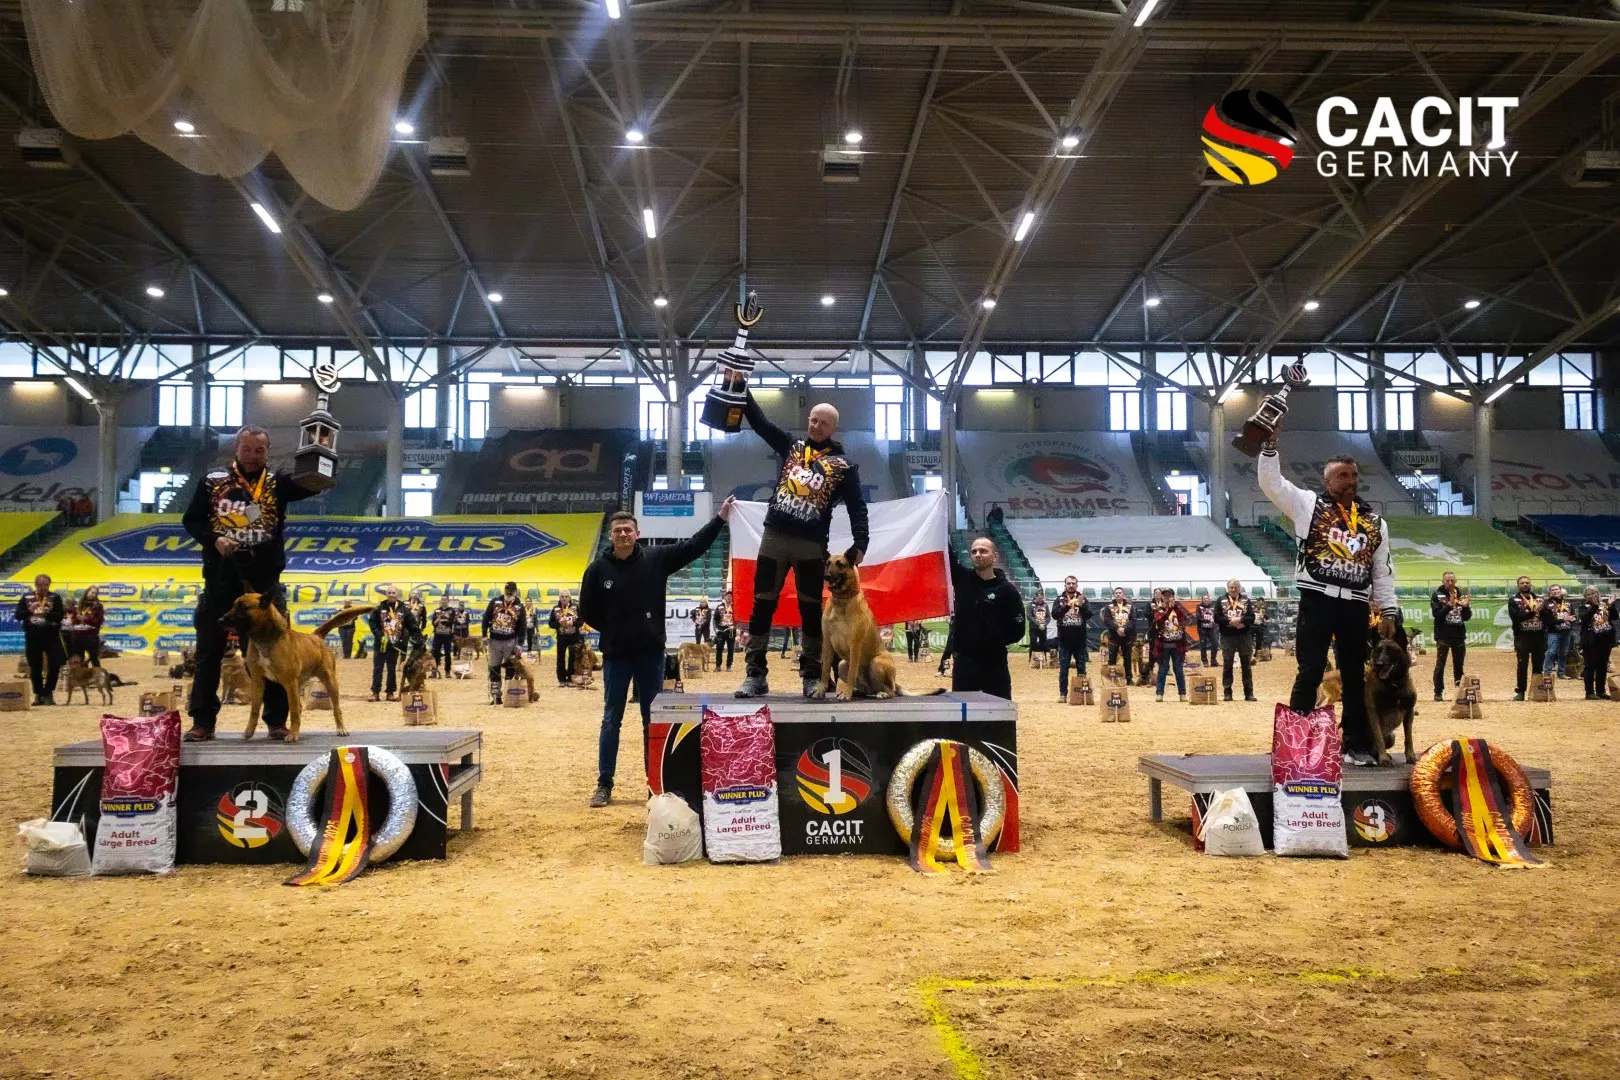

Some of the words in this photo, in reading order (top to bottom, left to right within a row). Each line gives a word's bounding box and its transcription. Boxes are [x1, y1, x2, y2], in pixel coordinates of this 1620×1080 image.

[906, 455, 942, 464] RESTAURA
[622, 466, 632, 500] SPORTS
[776, 491, 817, 515] CACIT
[773, 502, 812, 522] GERMANY
[326, 525, 421, 533] PREMIUM
[225, 528, 266, 543] ACIT
[374, 536, 506, 551] PLUS
[304, 556, 367, 566] FOOD
[1320, 556, 1366, 576] CACIT
[1318, 567, 1365, 584] GERMANY
[821, 749, 847, 804] 1
[717, 791, 747, 800] WINNER
[748, 790, 766, 798] PLUS
[1287, 785, 1318, 794] WINNER
[1320, 786, 1337, 794] PLUS
[102, 803, 132, 811] WINNER
[133, 802, 155, 811] PLUS
[233, 789, 268, 839] 2
[731, 815, 756, 825] Adult
[1301, 811, 1329, 820] Adult
[1287, 819, 1314, 828] Large
[1316, 819, 1342, 828] Breed
[1363, 805, 1386, 837] 3
[323, 819, 340, 839] 2025
[658, 828, 691, 840] POKUSA
[716, 824, 743, 834] Large
[744, 822, 771, 832] Breed
[805, 820, 864, 836] CACIT
[1222, 823, 1254, 833] POKUSA
[110, 830, 141, 839] Adult
[805, 836, 864, 845] GERMANY
[125, 837, 157, 847] Breed
